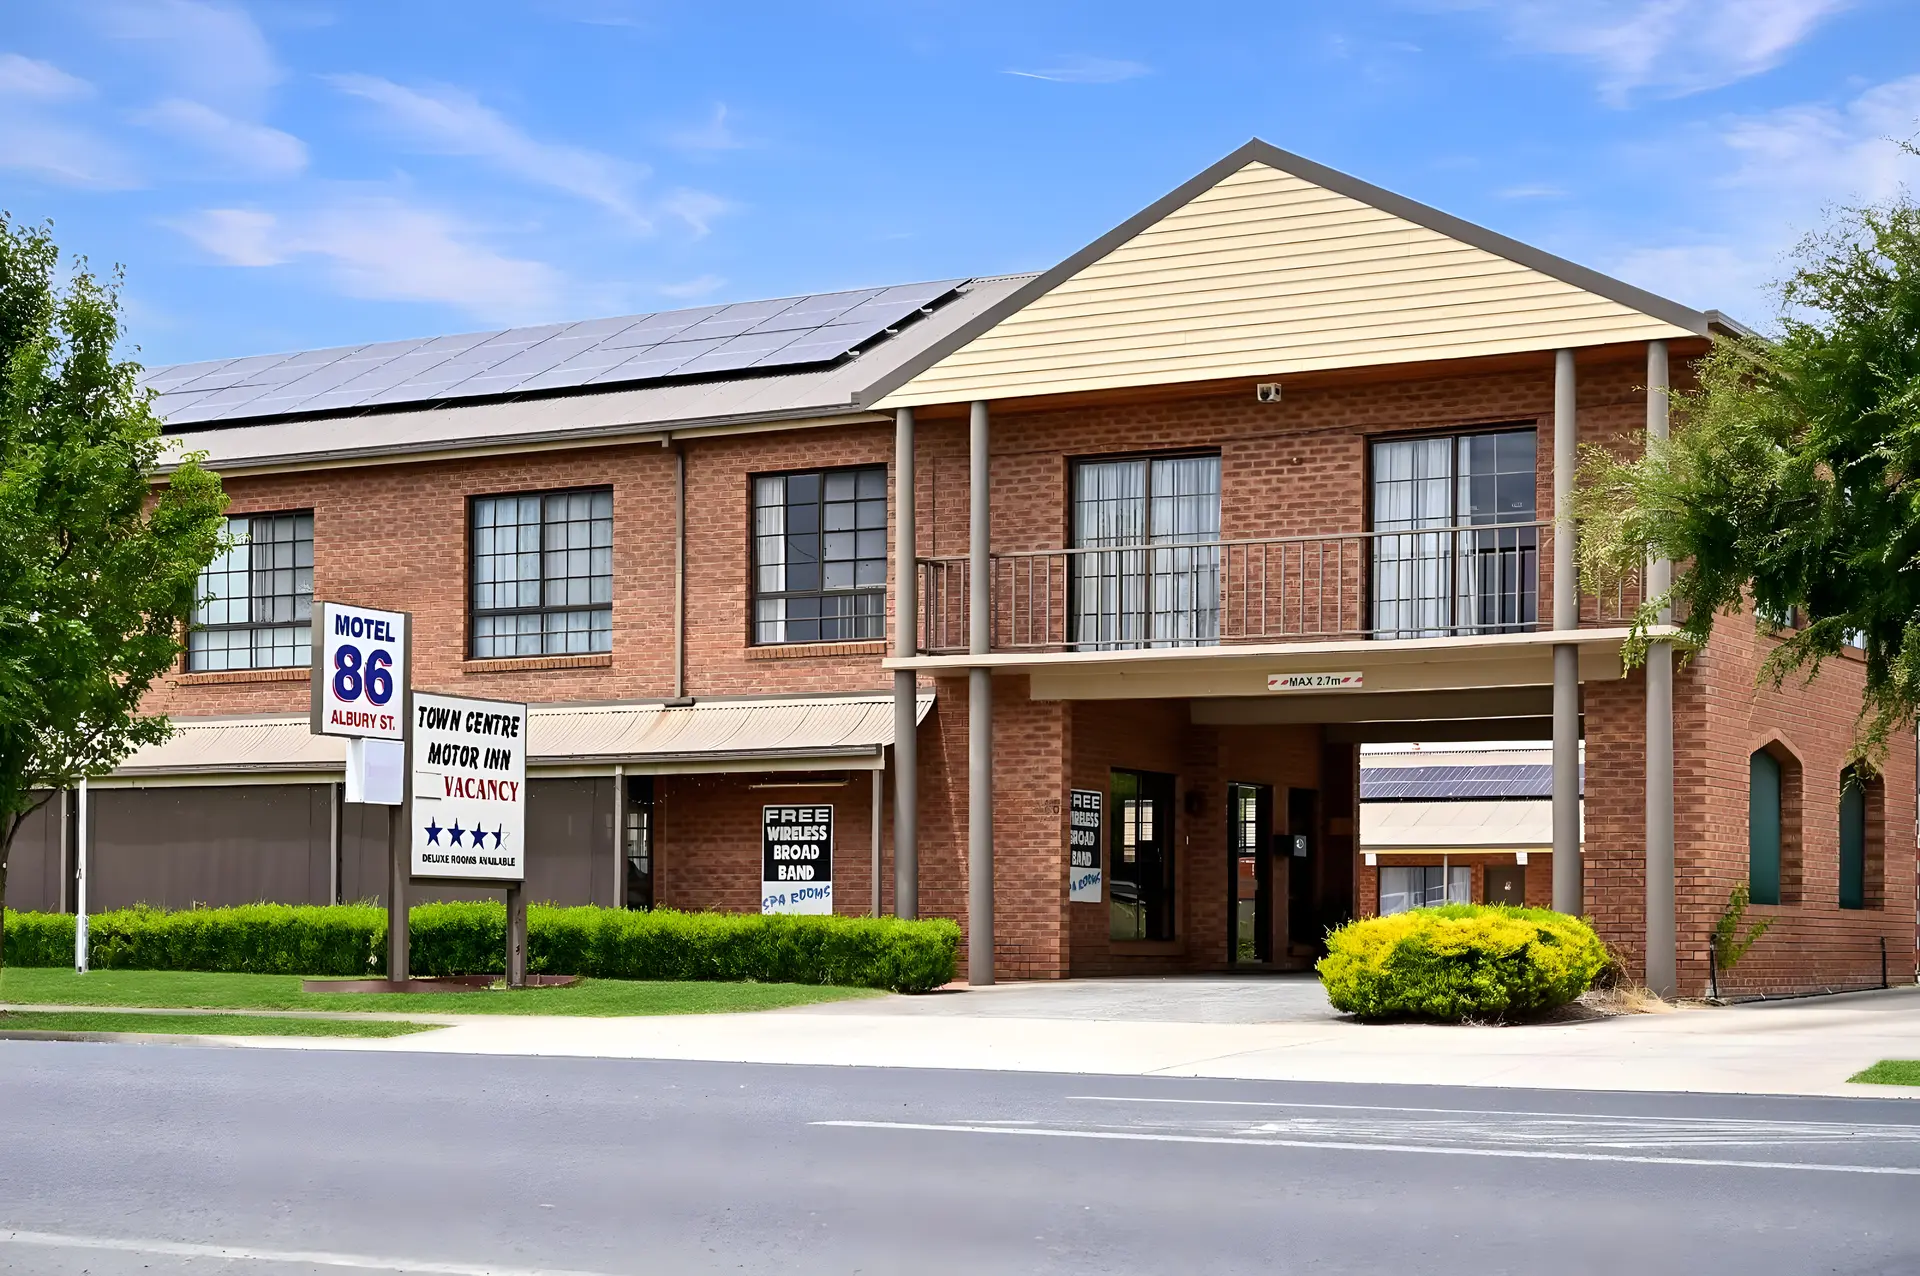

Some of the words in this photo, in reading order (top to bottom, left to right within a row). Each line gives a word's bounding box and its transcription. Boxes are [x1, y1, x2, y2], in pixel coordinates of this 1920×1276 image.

[334, 613, 395, 642] MOTEL
[332, 644, 393, 706] 86
[1289, 676, 1313, 686] MAX
[1316, 675, 1341, 686] 2.7m
[331, 709, 377, 729] ALBURY
[379, 714, 396, 731] ST.
[418, 705, 462, 731] TOWN
[465, 711, 520, 738] CENTRE
[427, 741, 480, 770] MOTOR
[483, 747, 512, 771] INN
[444, 775, 519, 802] VACANCY
[765, 809, 829, 823] FREE
[1070, 810, 1099, 828] IRELESS
[766, 825, 828, 841] WIRELESS
[422, 853, 450, 864] DELUXE
[450, 854, 477, 865] ROOMS
[478, 856, 516, 867] AVAILABLE
[773, 844, 820, 860] BROAD
[1071, 850, 1092, 867] BAND
[777, 864, 815, 881] BAND
[762, 893, 786, 911] SPA
[790, 885, 831, 904] ROOMS
